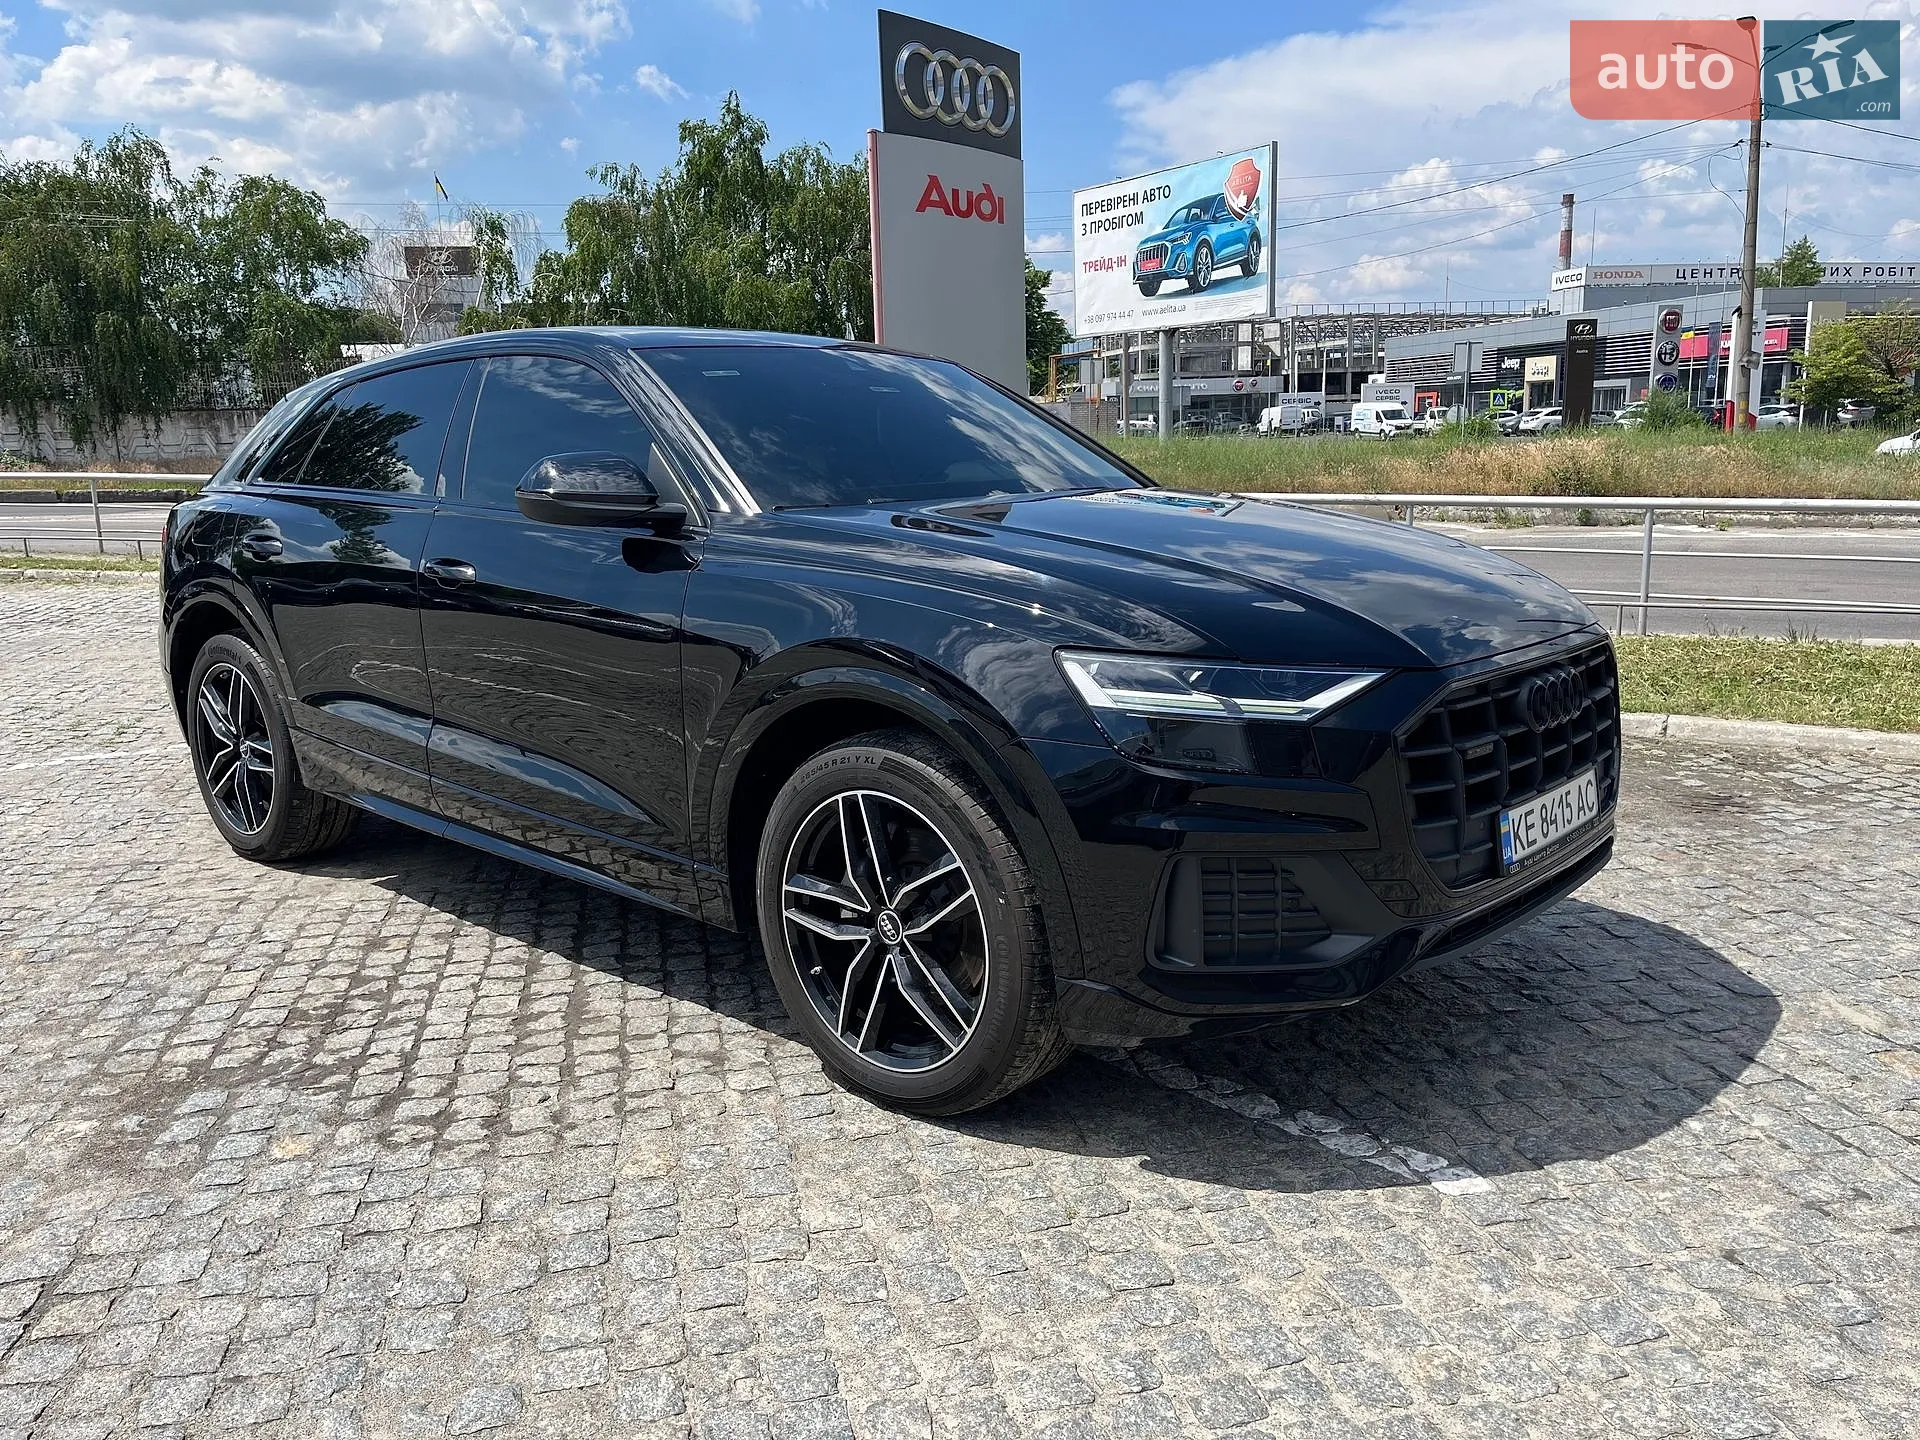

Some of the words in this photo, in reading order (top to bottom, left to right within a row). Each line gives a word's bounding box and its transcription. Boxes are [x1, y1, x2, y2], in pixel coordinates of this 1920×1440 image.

[915, 174, 1005, 224] Audi
[1081, 192, 1139, 217] ПЕРЕВІРЕНІ
[1142, 185, 1171, 204] АВТО
[1081, 223, 1087, 236] З
[1090, 211, 1144, 234] ПРОБІГОМ
[1083, 255, 1127, 274] ТРЕЙД-ІН
[1863, 266, 1916, 277] РОБІТ
[1555, 272, 1583, 285] IVECO
[1593, 270, 1644, 280] HONDA
[1676, 267, 1740, 280] ЦЕНТР
[1142, 304, 1186, 317] www.aelita.ua
[1501, 356, 1520, 371] Jeep
[1531, 362, 1549, 377] Jeep
[864, 756, 876, 765] XL
[1511, 808, 1538, 855] KE
[1540, 790, 1573, 839] 8415
[1577, 779, 1595, 820] AC
[1503, 846, 1512, 859] UA
